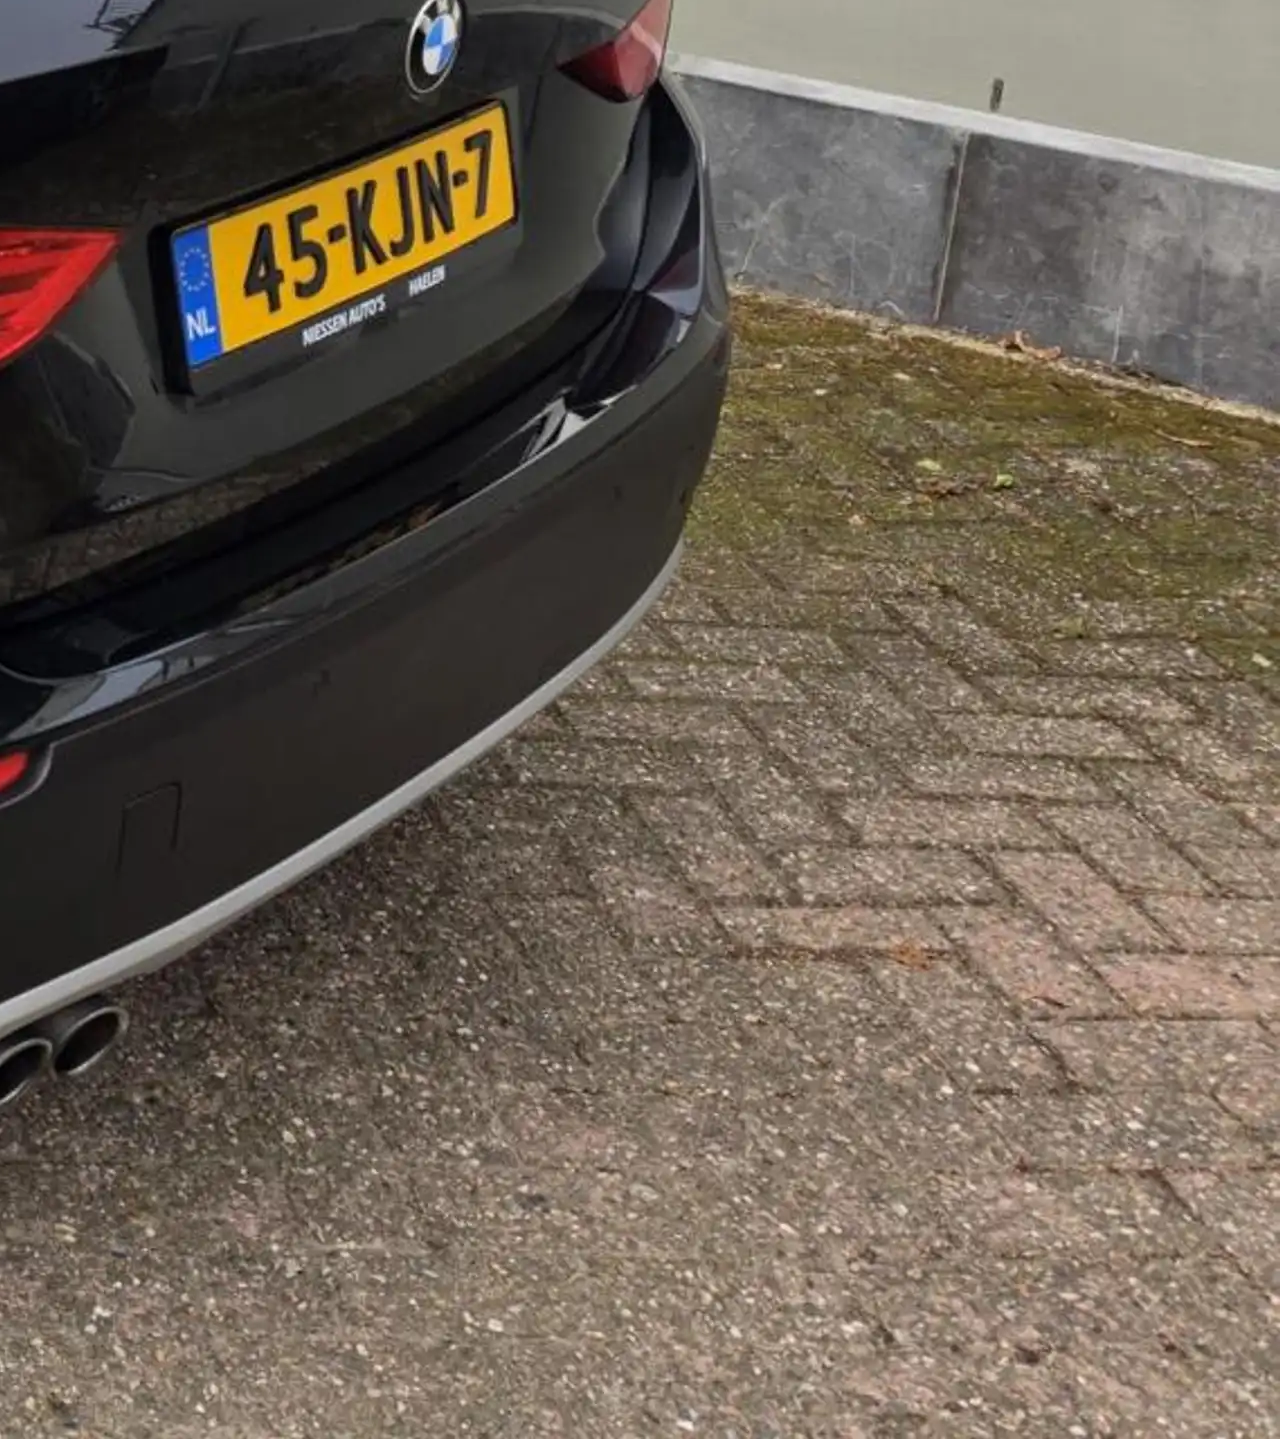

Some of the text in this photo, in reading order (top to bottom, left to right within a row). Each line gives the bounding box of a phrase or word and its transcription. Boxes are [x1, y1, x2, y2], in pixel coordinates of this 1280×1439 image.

[243, 129, 494, 315] 45-KJN-7
[186, 308, 217, 340] NL
[302, 311, 348, 347] NIESSEN
[348, 293, 386, 327] AUTO'S
